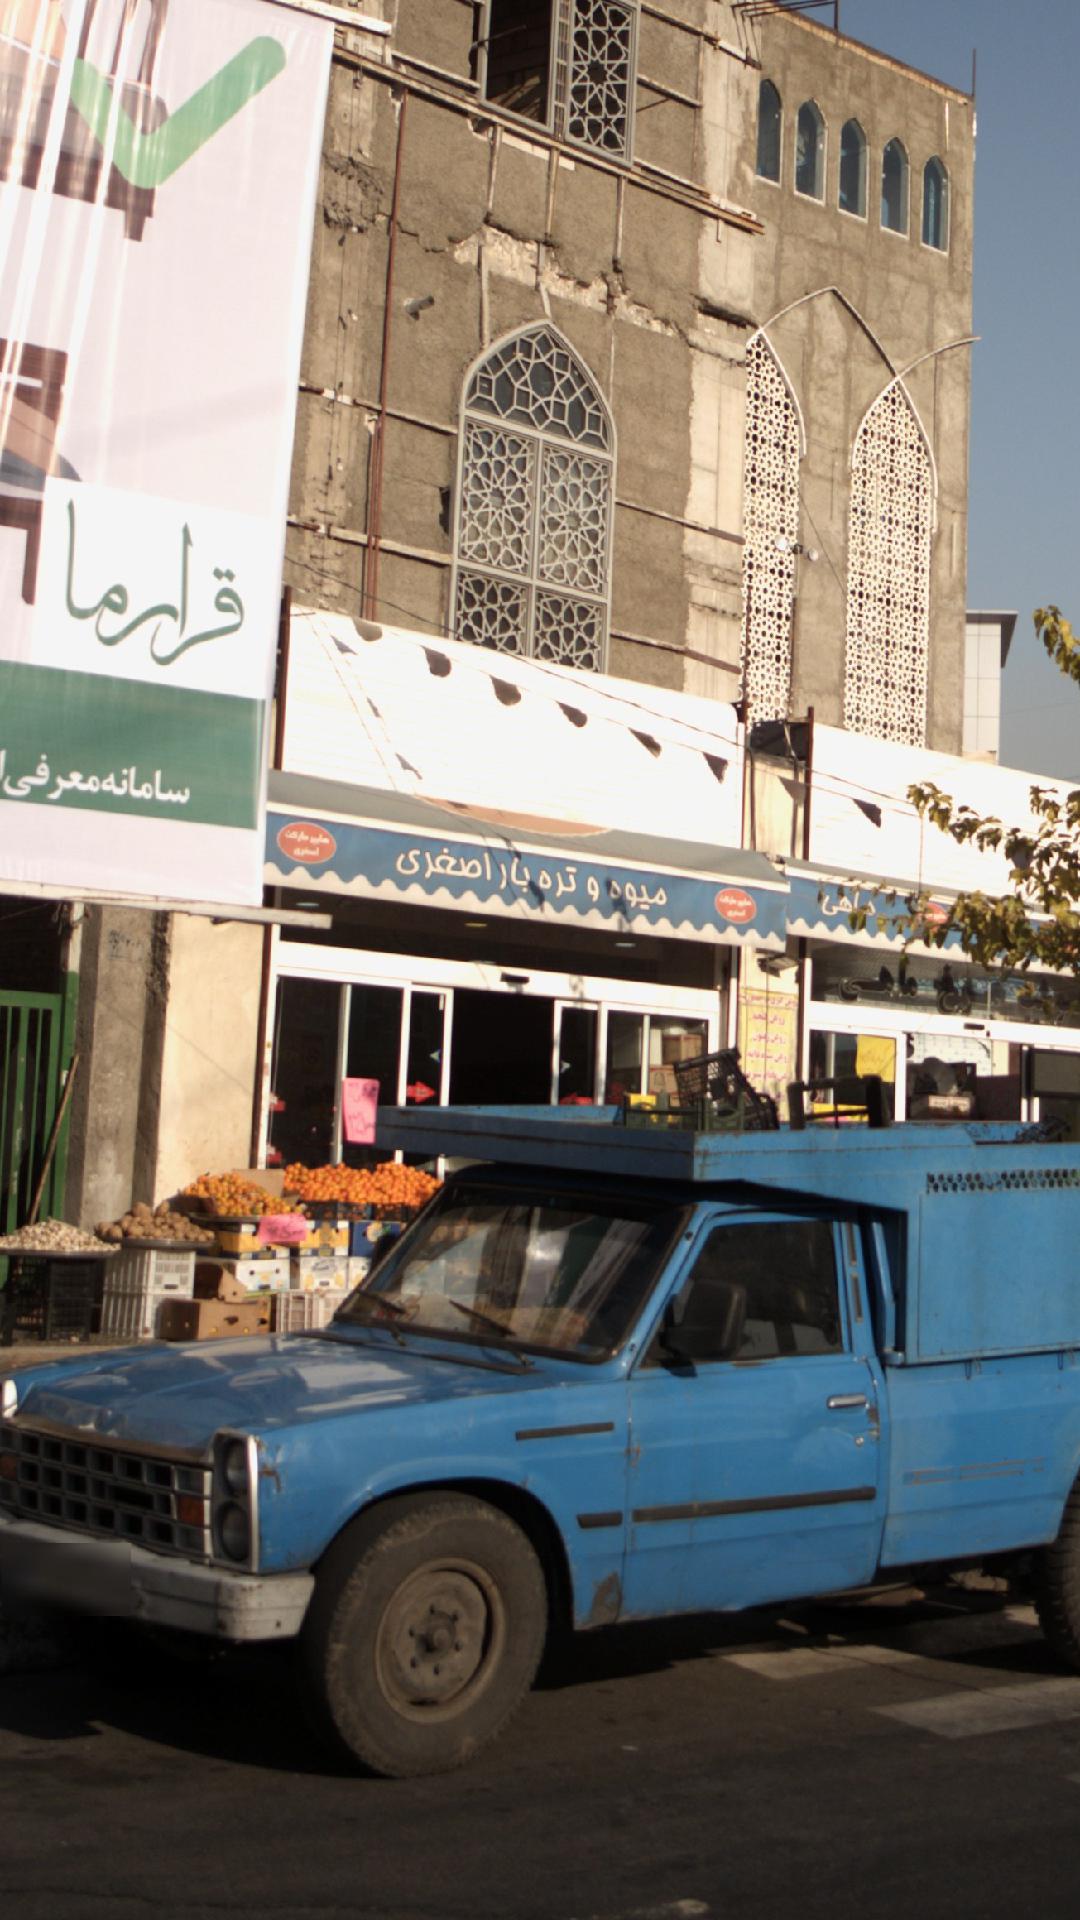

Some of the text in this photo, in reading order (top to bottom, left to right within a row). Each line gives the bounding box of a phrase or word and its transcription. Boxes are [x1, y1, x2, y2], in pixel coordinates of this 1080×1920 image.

[395, 847, 492, 881] اصغری
[586, 875, 599, 902] و
[608, 879, 668, 911] میوه
